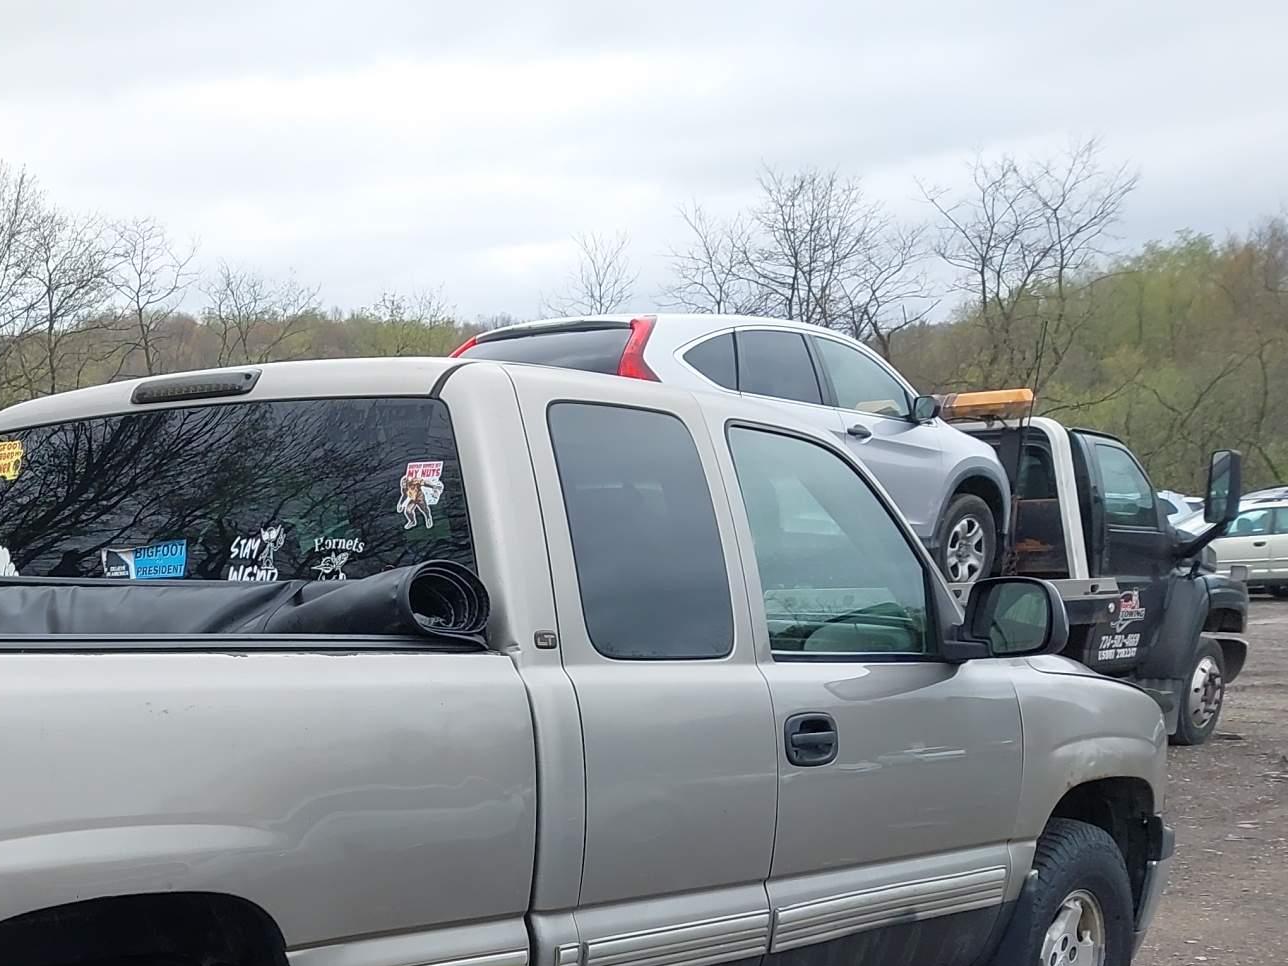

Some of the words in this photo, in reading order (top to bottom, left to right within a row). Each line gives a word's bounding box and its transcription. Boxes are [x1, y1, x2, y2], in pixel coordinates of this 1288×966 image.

[408, 469, 420, 478] MY
[421, 469, 440, 477] NUTS
[135, 543, 185, 559] BIGFOOT
[230, 535, 261, 559] STAY
[314, 536, 365, 553] Hornets
[137, 564, 184, 577] PRESIDENT
[537, 634, 555, 646] LT
